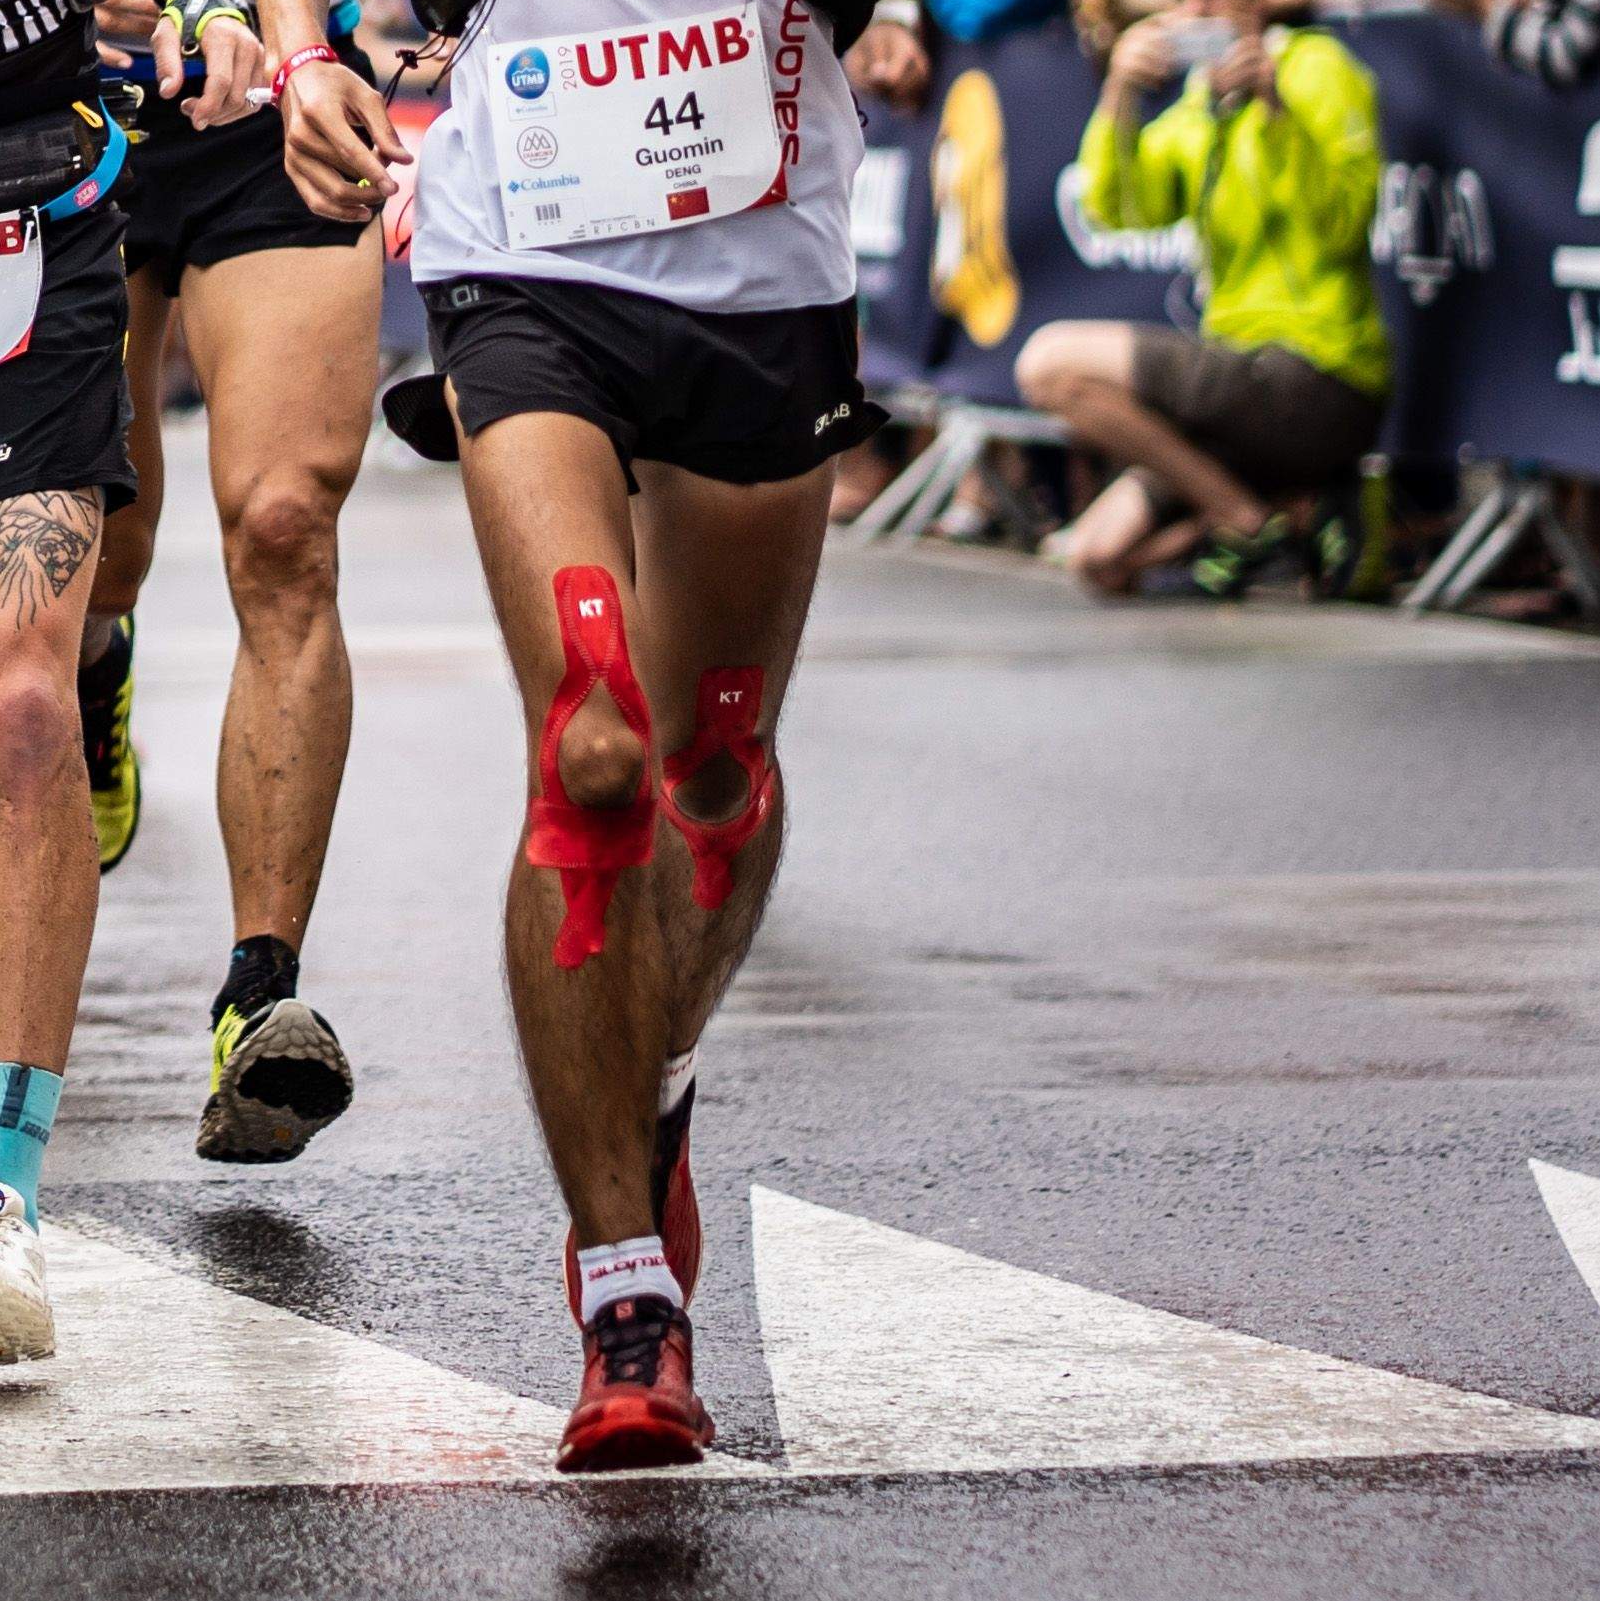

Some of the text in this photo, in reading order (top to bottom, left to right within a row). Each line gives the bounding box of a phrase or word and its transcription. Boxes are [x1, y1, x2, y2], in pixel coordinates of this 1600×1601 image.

[290, 47, 329, 67] UTMB
[575, 16, 750, 88] UTMB
[557, 46, 578, 90] 2019
[511, 73, 545, 87] UTMB
[644, 91, 705, 136] 44
[635, 136, 724, 167] Guomin
[665, 164, 702, 180] DENG
[520, 173, 581, 193] Columbia
[672, 179, 698, 189] CHINA
[578, 598, 604, 618] KT
[719, 691, 743, 704] KT
